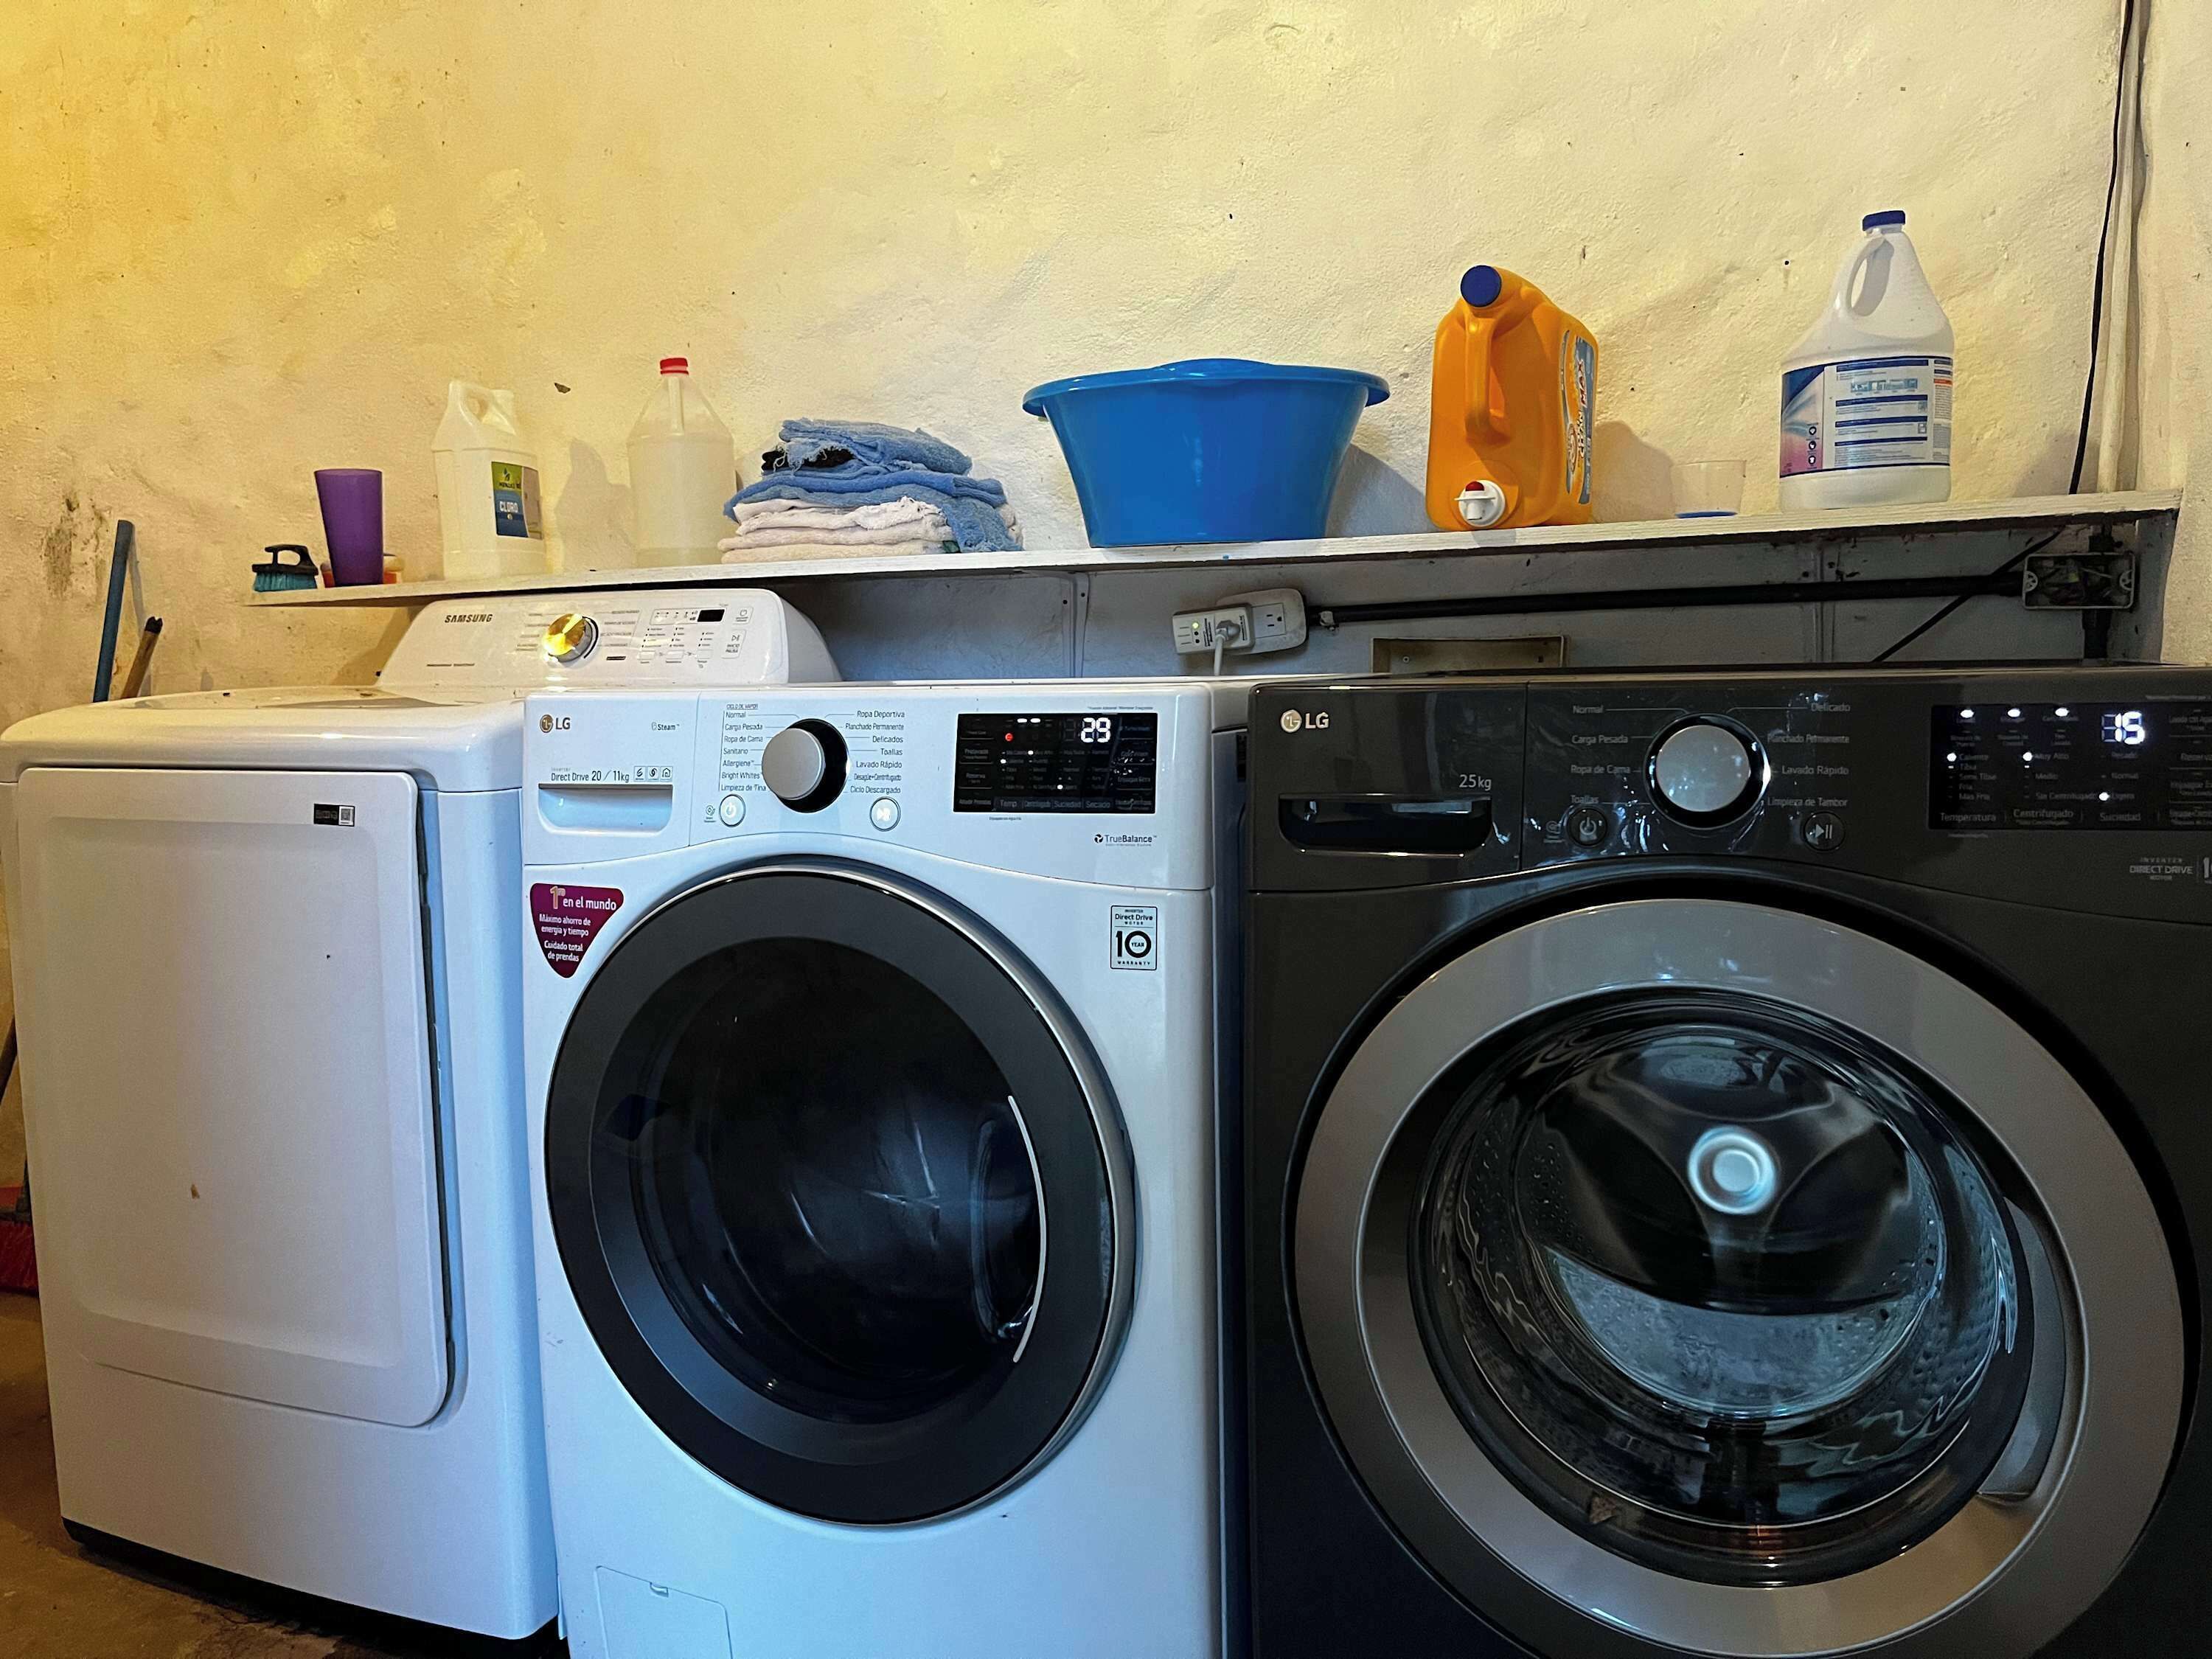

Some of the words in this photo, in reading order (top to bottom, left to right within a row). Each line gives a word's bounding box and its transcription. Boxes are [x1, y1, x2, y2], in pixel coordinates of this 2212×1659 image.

[445, 614, 493, 623] SAMSUNG
[1573, 705, 1604, 714] Normal
[1811, 703, 1851, 712] Delicado
[858, 710, 873, 718] Ropa
[874, 710, 905, 719] Deportiva
[555, 717, 571, 731] LG
[1304, 712, 1329, 729] LG
[725, 723, 741, 732] Carga
[845, 723, 872, 731] Planchado
[873, 723, 905, 731] Permanente
[1081, 717, 1111, 743] 29
[724, 736, 738, 744] Ropa
[872, 735, 904, 743] Delicados
[1571, 735, 1596, 745] Carga
[1598, 734, 1628, 743] Pesada
[880, 748, 903, 756] Toallas
[880, 760, 902, 769] Rápido
[1571, 765, 1592, 776] Ropa
[1593, 765, 1605, 773] de
[1606, 765, 1631, 774] Cama
[1781, 765, 1815, 775] Lavado
[551, 772, 571, 782] Direct
[571, 772, 589, 782] Drive
[591, 770, 602, 781] 20
[613, 770, 630, 783] 11kg
[722, 772, 739, 780] Bright
[1458, 773, 1492, 791] 25kg
[721, 784, 745, 792] Limpieza
[745, 784, 753, 792] de
[850, 785, 865, 793] Ciclo
[865, 785, 901, 795] Descargado
[1571, 794, 1599, 803] Toallas
[1767, 796, 1804, 808] Limpieza
[1805, 797, 1817, 807] de
[1817, 796, 1848, 807] Tambor
[1940, 812, 1997, 823] Temperatura
[2013, 808, 2075, 820] Centrifugado
[2129, 865, 2163, 874] DIRECT
[2164, 866, 2194, 875] DRIVE
[563, 898, 574, 908] en
[575, 896, 583, 908] el
[585, 898, 617, 911] mundo
[539, 913, 562, 924] Máximo
[563, 917, 582, 926] ahorro
[582, 918, 591, 926] de
[541, 925, 563, 936] energía
[563, 928, 568, 936] y
[568, 927, 589, 938] tiempo
[544, 940, 568, 950] Cuidado
[568, 943, 583, 951] total
[1116, 931, 1152, 959] 10
[547, 951, 554, 959] de
[555, 952, 580, 962] prendas
